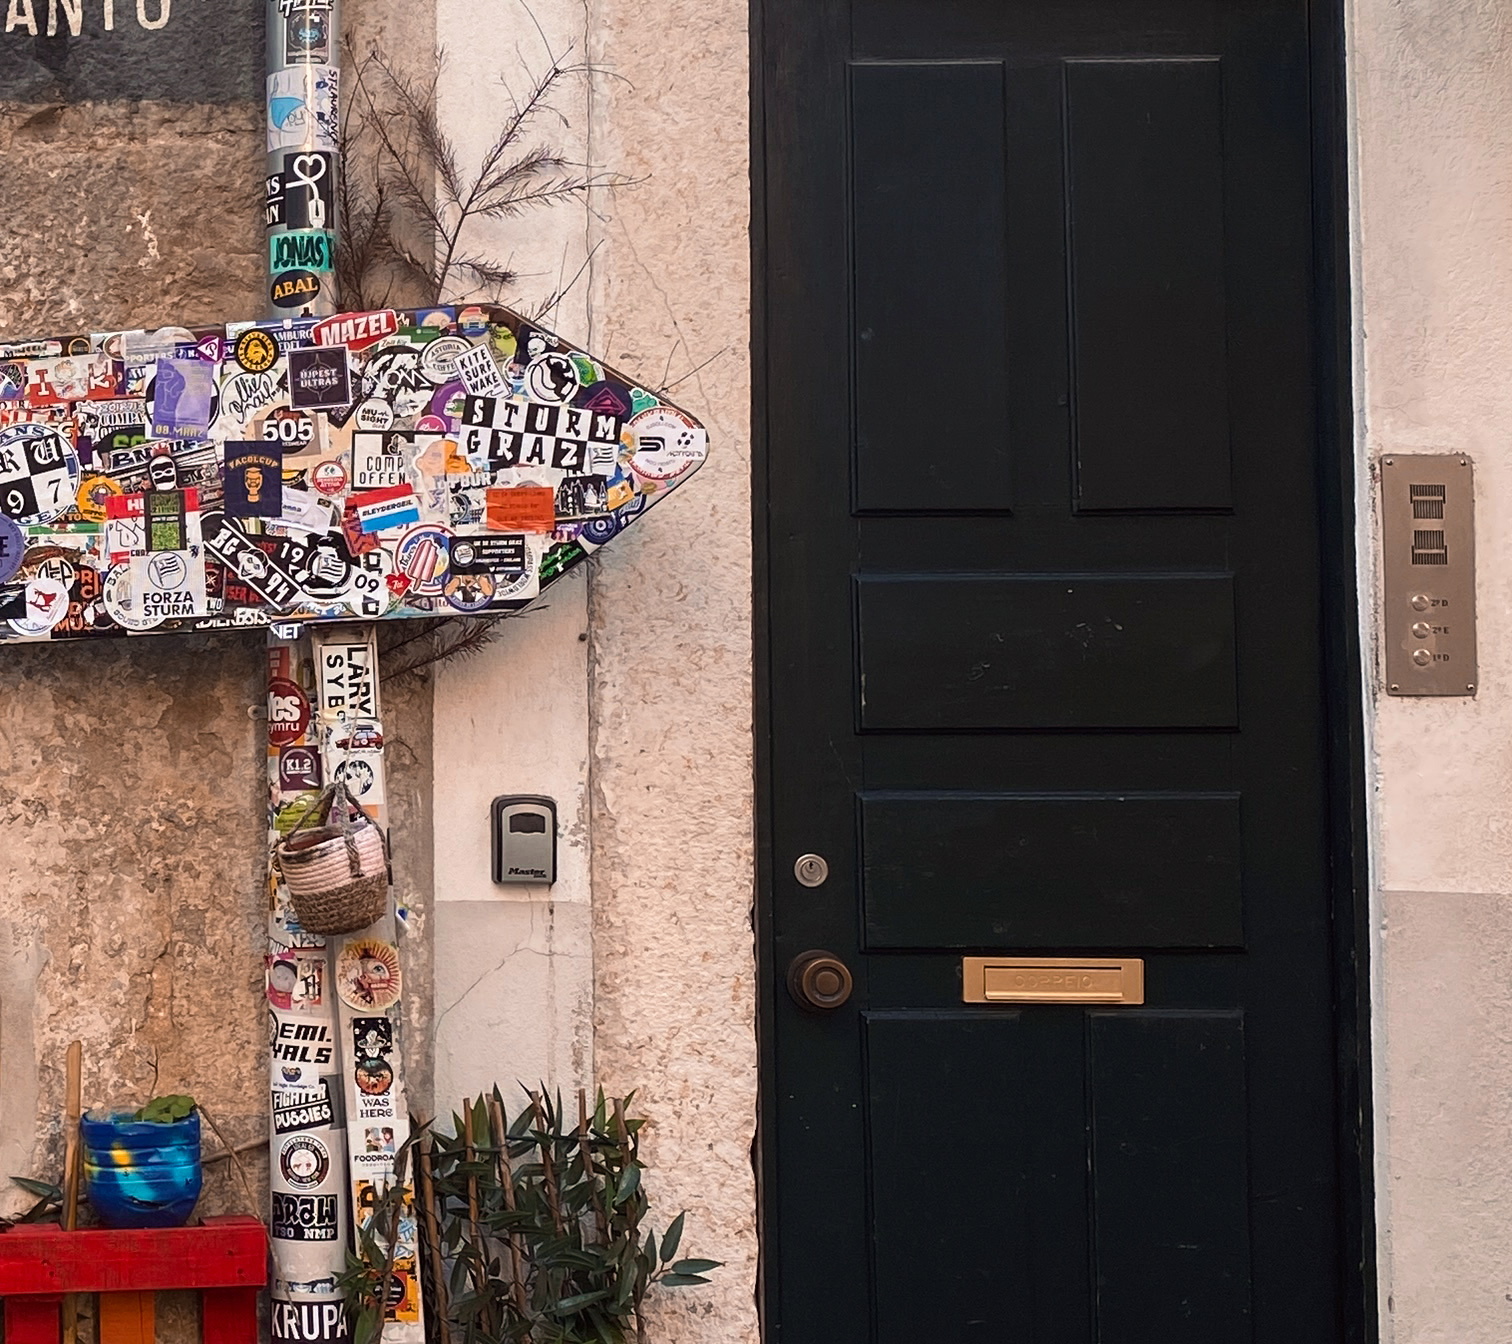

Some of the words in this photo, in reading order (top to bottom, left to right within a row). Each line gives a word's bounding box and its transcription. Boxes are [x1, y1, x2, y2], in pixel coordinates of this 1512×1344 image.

[273, 237, 324, 269] JONAS
[273, 280, 318, 301] ABAL
[320, 316, 392, 347] MAZEL
[459, 349, 488, 371] KITE
[464, 363, 493, 382] SURF
[300, 377, 339, 388] ULTRAS
[469, 373, 500, 393] WAKE
[263, 418, 314, 441] 505
[473, 399, 616, 441] STURM
[467, 429, 580, 467] GRAZ
[366, 456, 403, 472] COMP
[359, 471, 407, 485] OFFEN
[280, 542, 305, 563] 19
[354, 574, 380, 594] 09
[143, 592, 194, 605] FORZA
[1441, 599, 1449, 607] D
[144, 604, 195, 617] STURM
[1443, 654, 1450, 662] D
[286, 759, 312, 771] K1.2
[362, 1098, 390, 1107] WAS
[360, 1109, 393, 1118] HERE
[303, 1227, 335, 1240] NMP
[272, 1302, 348, 1342] KRUPA
